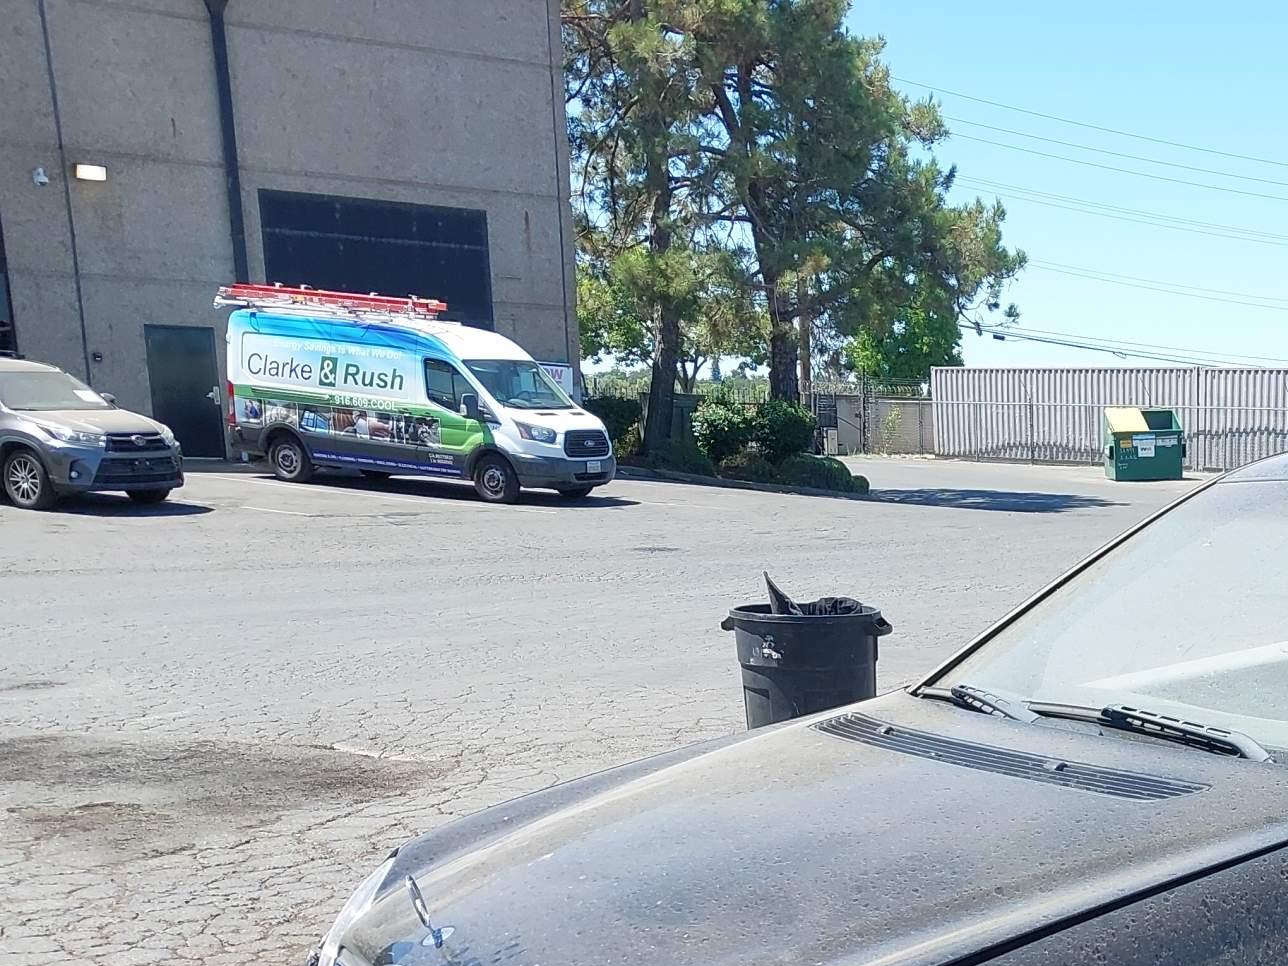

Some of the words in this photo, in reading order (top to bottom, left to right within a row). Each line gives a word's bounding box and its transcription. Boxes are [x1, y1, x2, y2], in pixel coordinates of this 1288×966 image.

[247, 352, 313, 380] Clarke
[320, 359, 336, 384] &
[343, 363, 404, 391] Rush
[334, 395, 397, 410] 916.609.COOL
